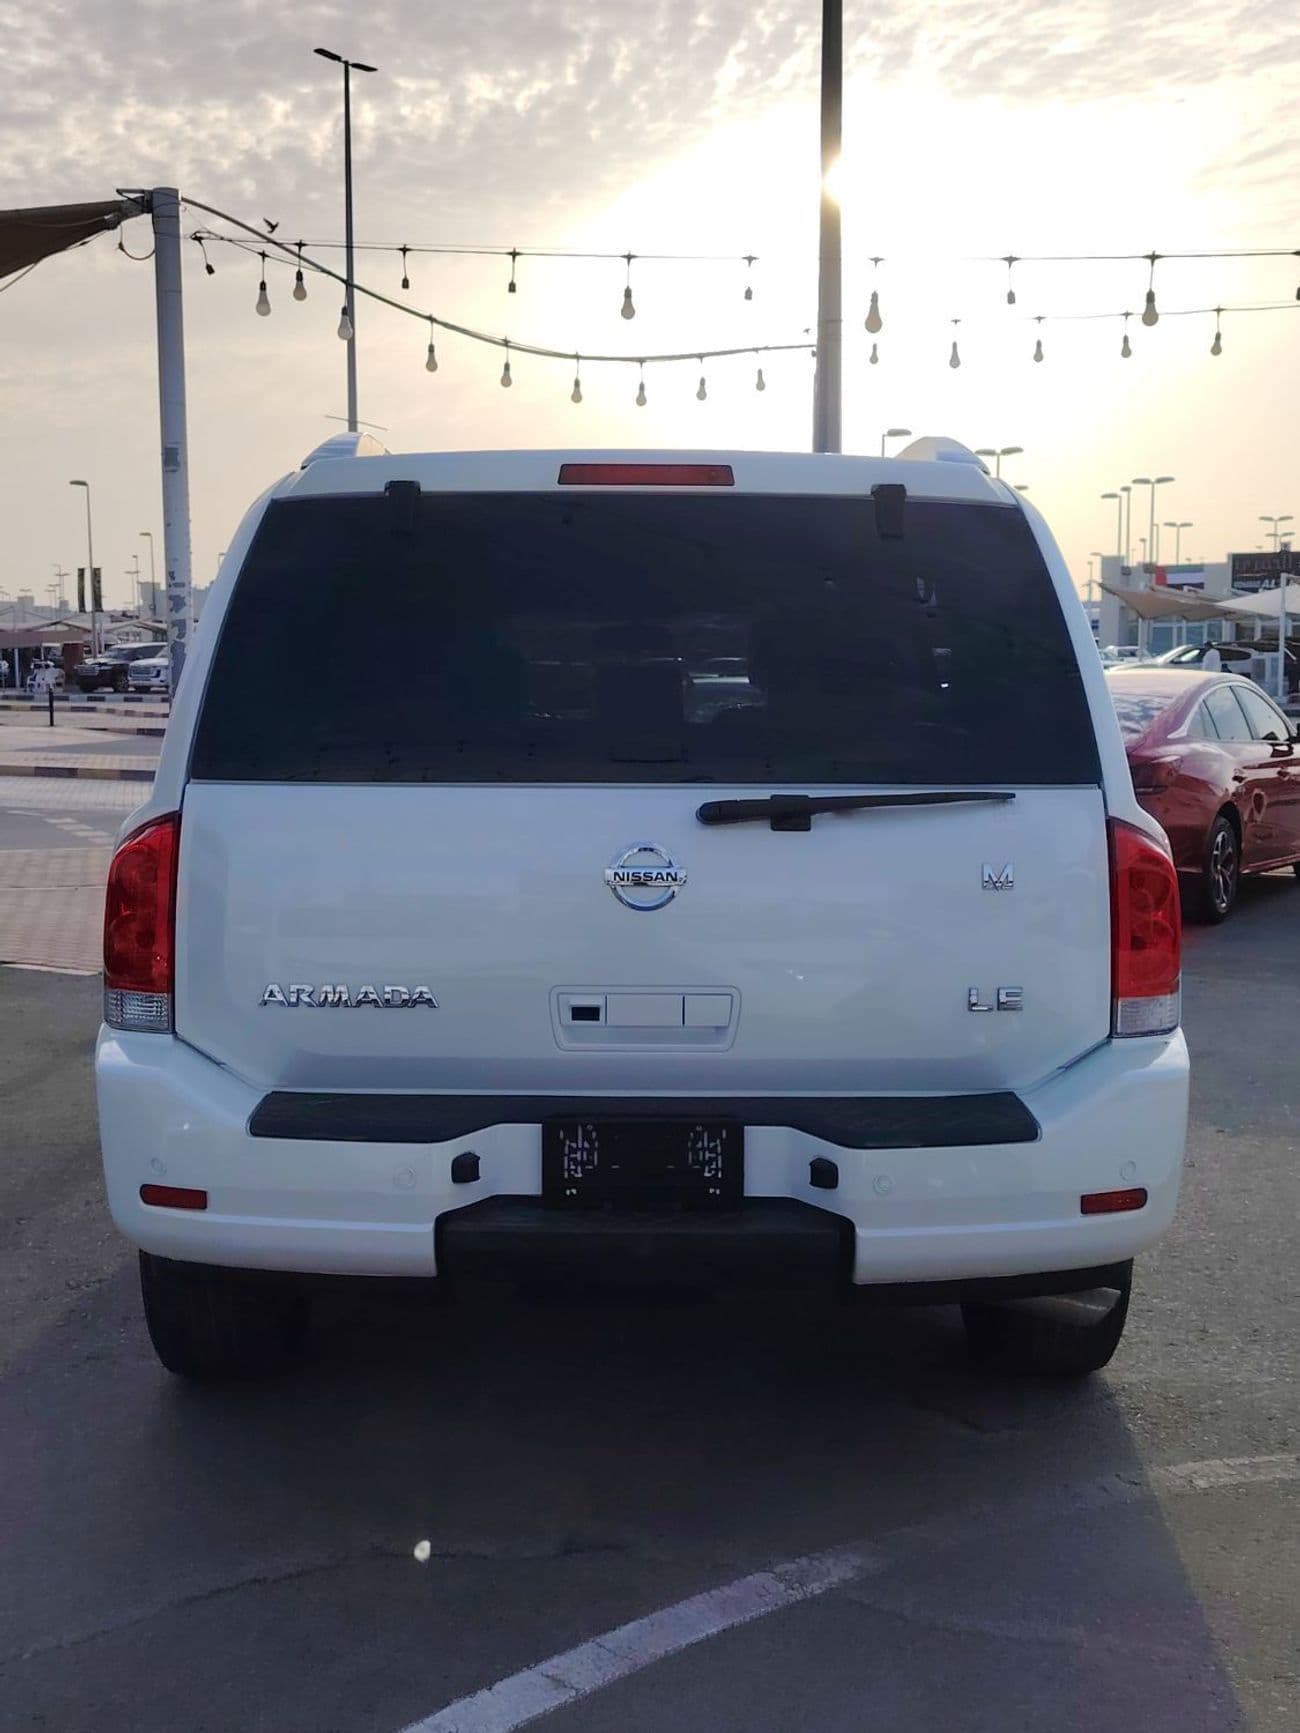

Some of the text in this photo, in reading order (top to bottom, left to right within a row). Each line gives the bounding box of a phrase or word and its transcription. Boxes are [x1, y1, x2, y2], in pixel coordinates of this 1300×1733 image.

[613, 871, 678, 882] NISSAN
[260, 984, 440, 1008] ARMADA
[968, 987, 1023, 1012] LE
